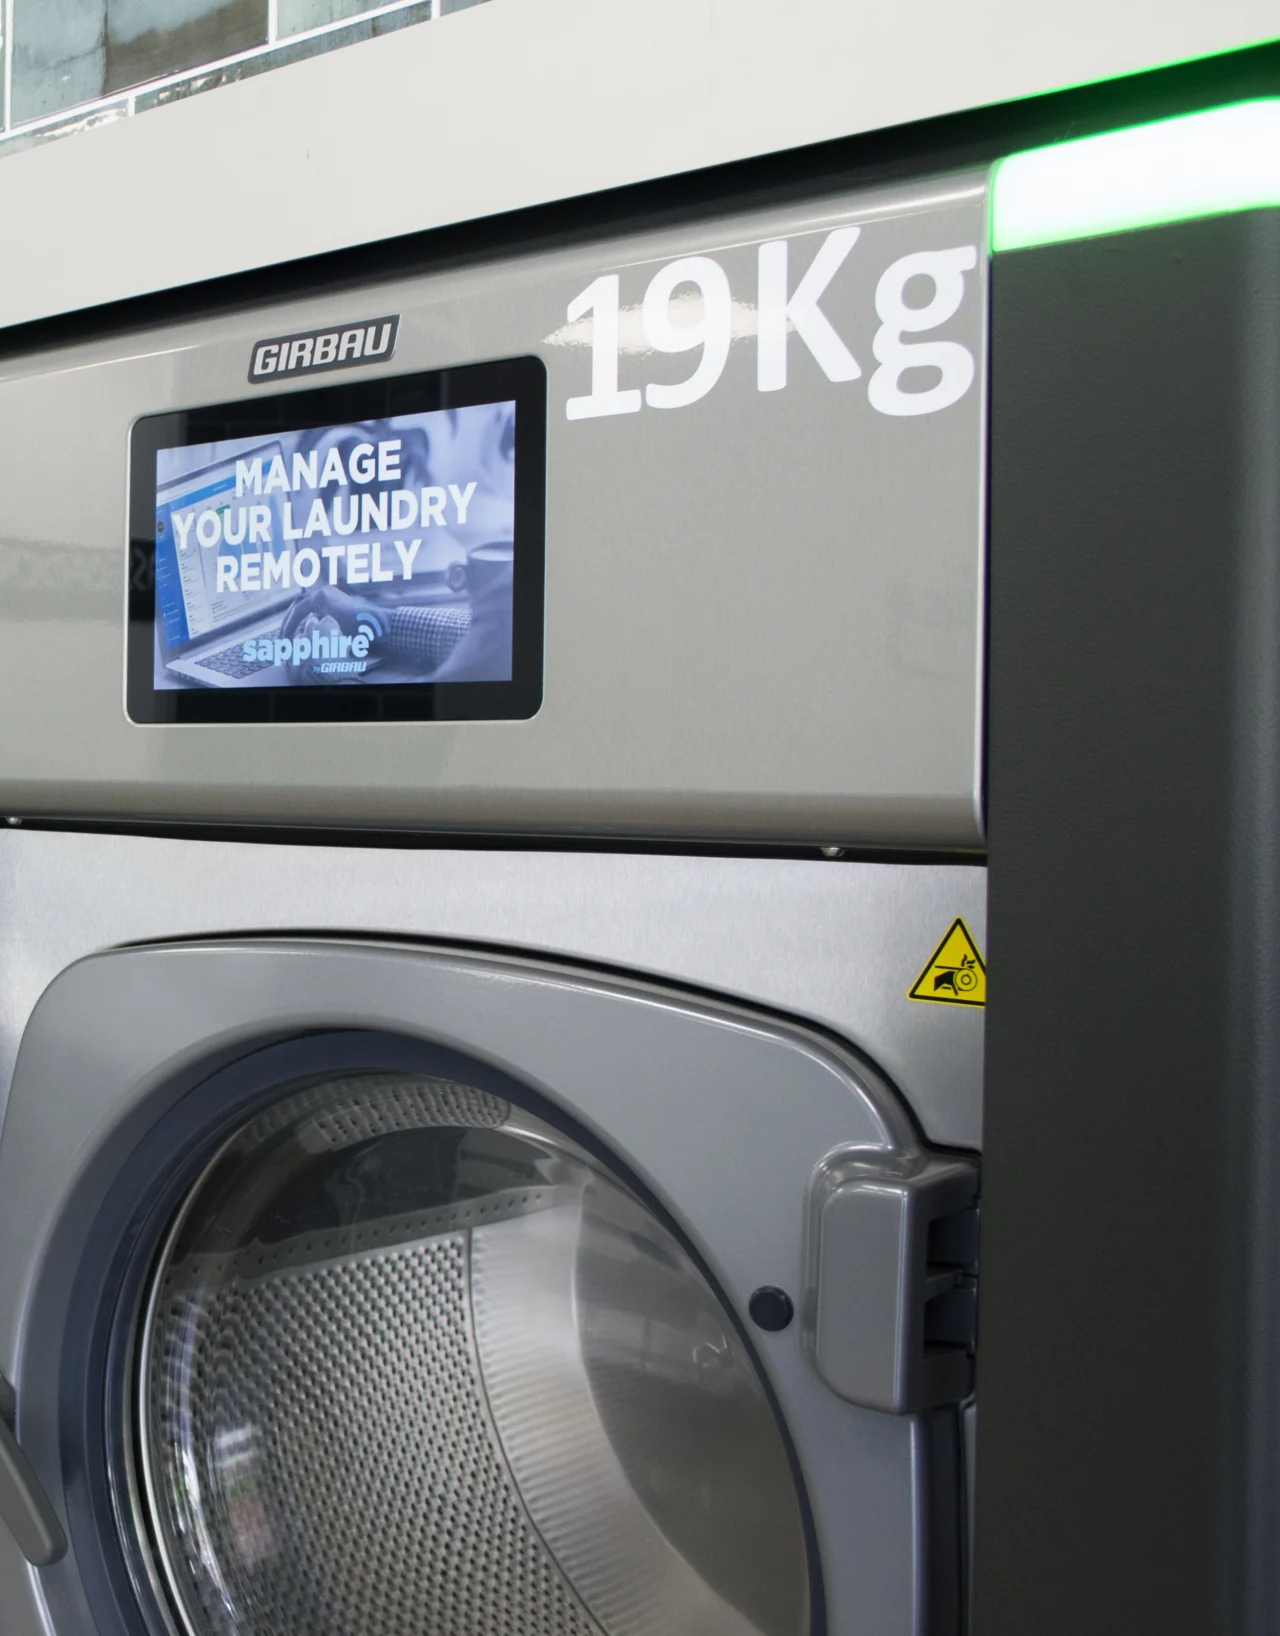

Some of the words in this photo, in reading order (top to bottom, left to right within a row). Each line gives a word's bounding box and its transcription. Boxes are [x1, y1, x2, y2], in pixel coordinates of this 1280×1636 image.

[253, 322, 393, 376] GIRBAU
[565, 226, 977, 421] 19Kg
[235, 440, 402, 497] MANAGE
[171, 503, 272, 550] YOUR
[282, 482, 478, 541] LAUNDRY
[216, 538, 423, 593] REMOTELY
[242, 629, 370, 667] sapphire
[321, 661, 367, 673] GIRBAU
